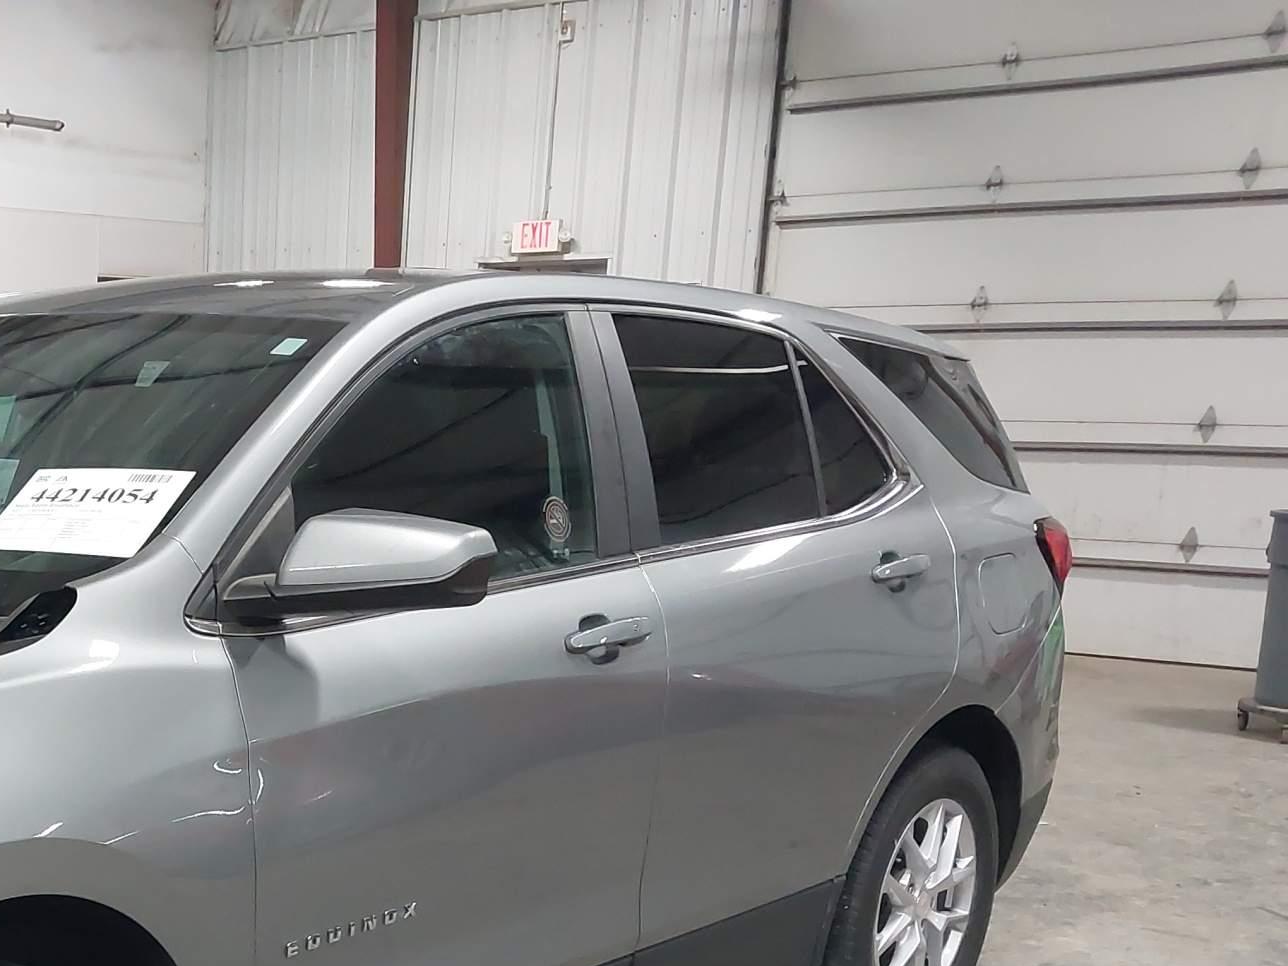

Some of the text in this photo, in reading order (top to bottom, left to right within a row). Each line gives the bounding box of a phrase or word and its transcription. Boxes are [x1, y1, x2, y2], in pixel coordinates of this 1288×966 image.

[520, 221, 552, 249] EXIT
[29, 487, 160, 504] 44214054
[285, 901, 418, 959] EQUINOX
